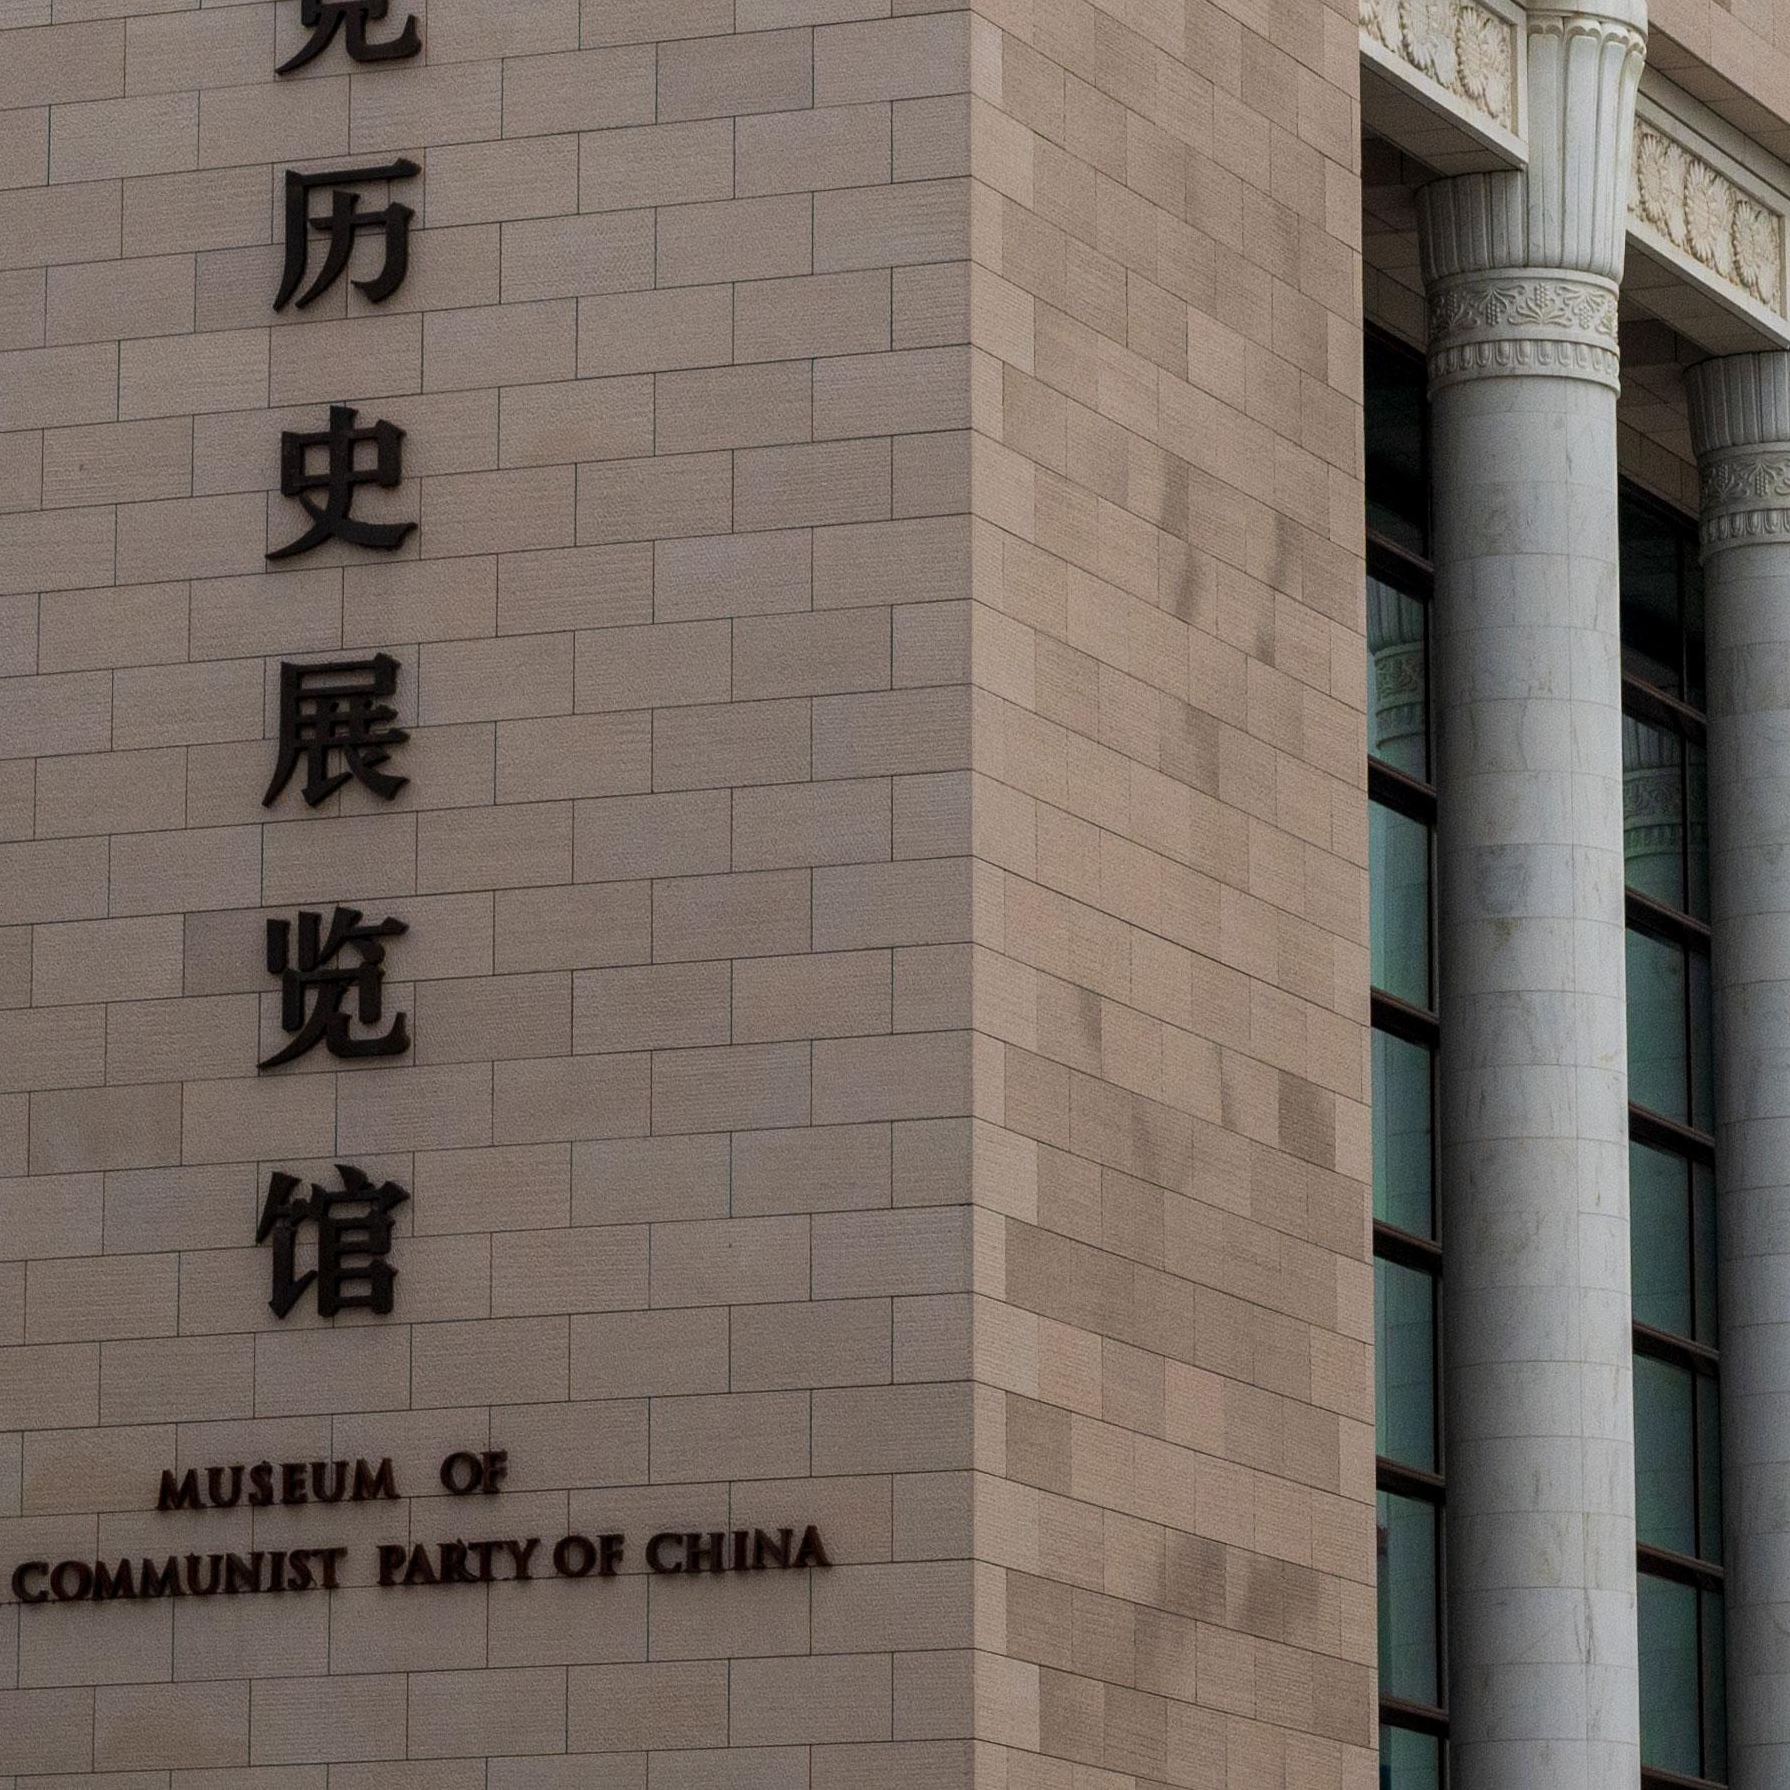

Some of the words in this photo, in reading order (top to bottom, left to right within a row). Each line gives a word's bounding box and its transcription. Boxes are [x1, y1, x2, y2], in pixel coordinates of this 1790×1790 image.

[156, 1457, 401, 1510] MUSEUM
[439, 1449, 509, 1496] OF
[11, 1546, 348, 1603] COMMUNIST
[376, 1538, 542, 1587] PARTY
[552, 1532, 626, 1578] OF
[645, 1524, 834, 1575] CHINA
